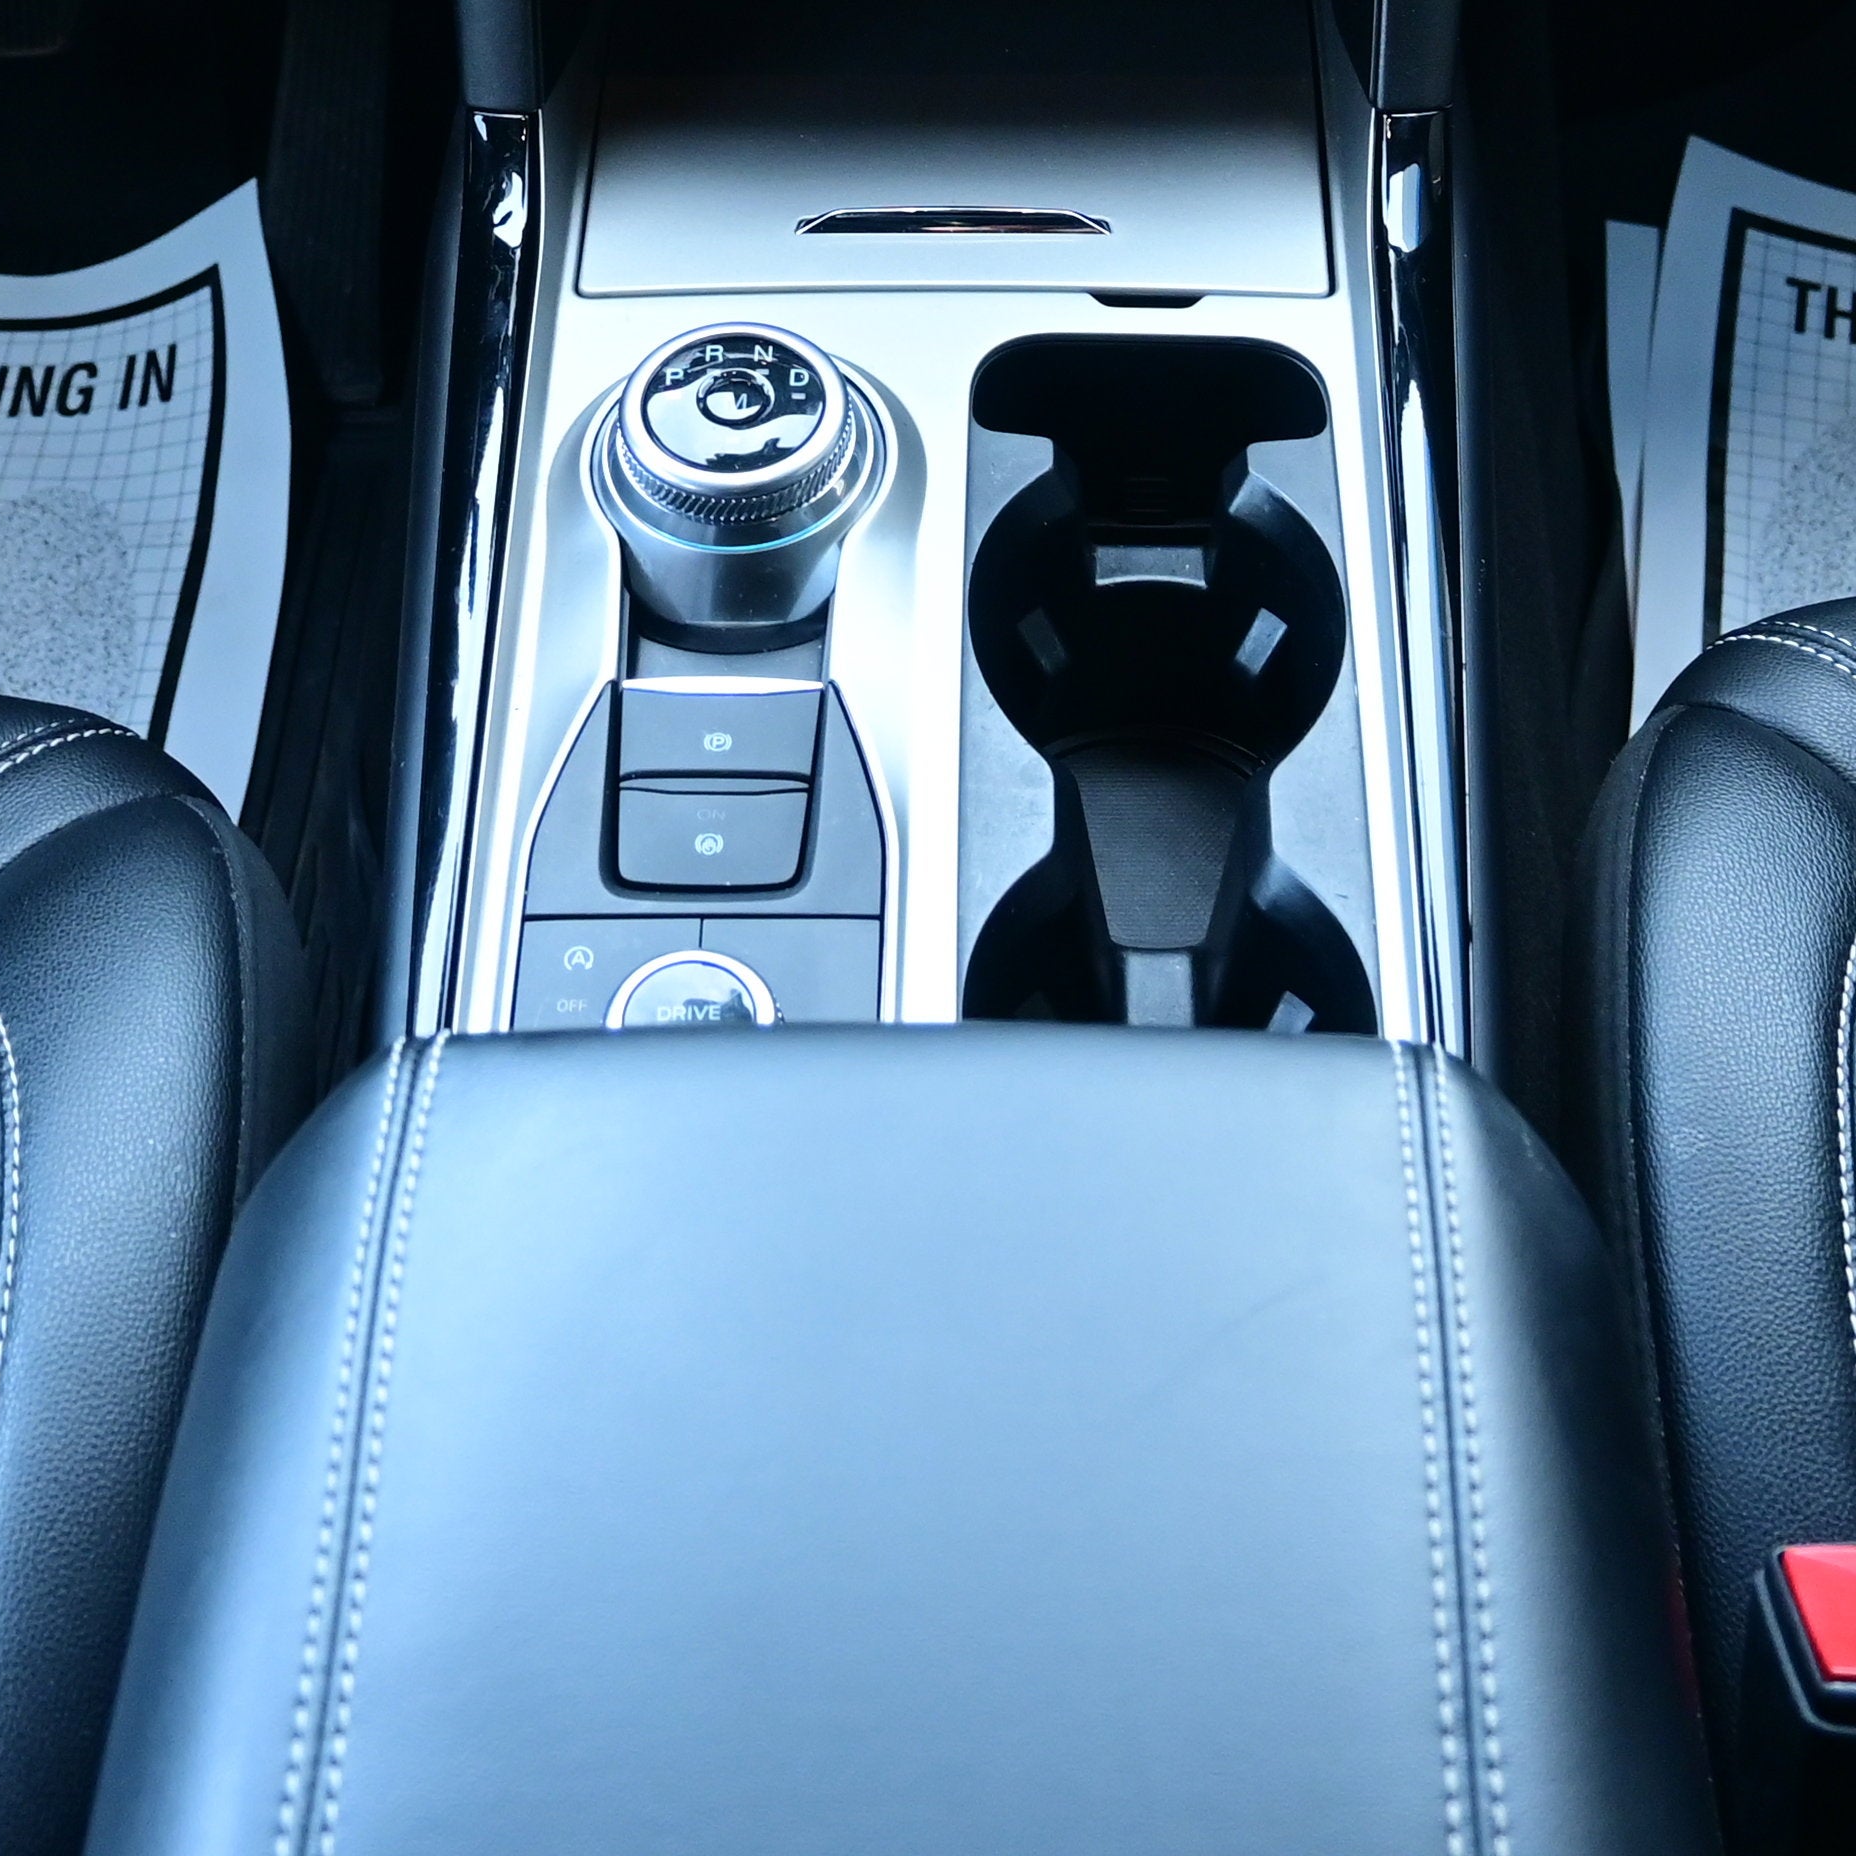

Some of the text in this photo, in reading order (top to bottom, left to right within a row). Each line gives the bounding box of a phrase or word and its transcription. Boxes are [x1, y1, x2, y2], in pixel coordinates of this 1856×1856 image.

[117, 342, 178, 412] IN
[665, 344, 810, 387] P R N D
[556, 999, 588, 1013] OFF
[656, 1005, 721, 1022] DRIVE
